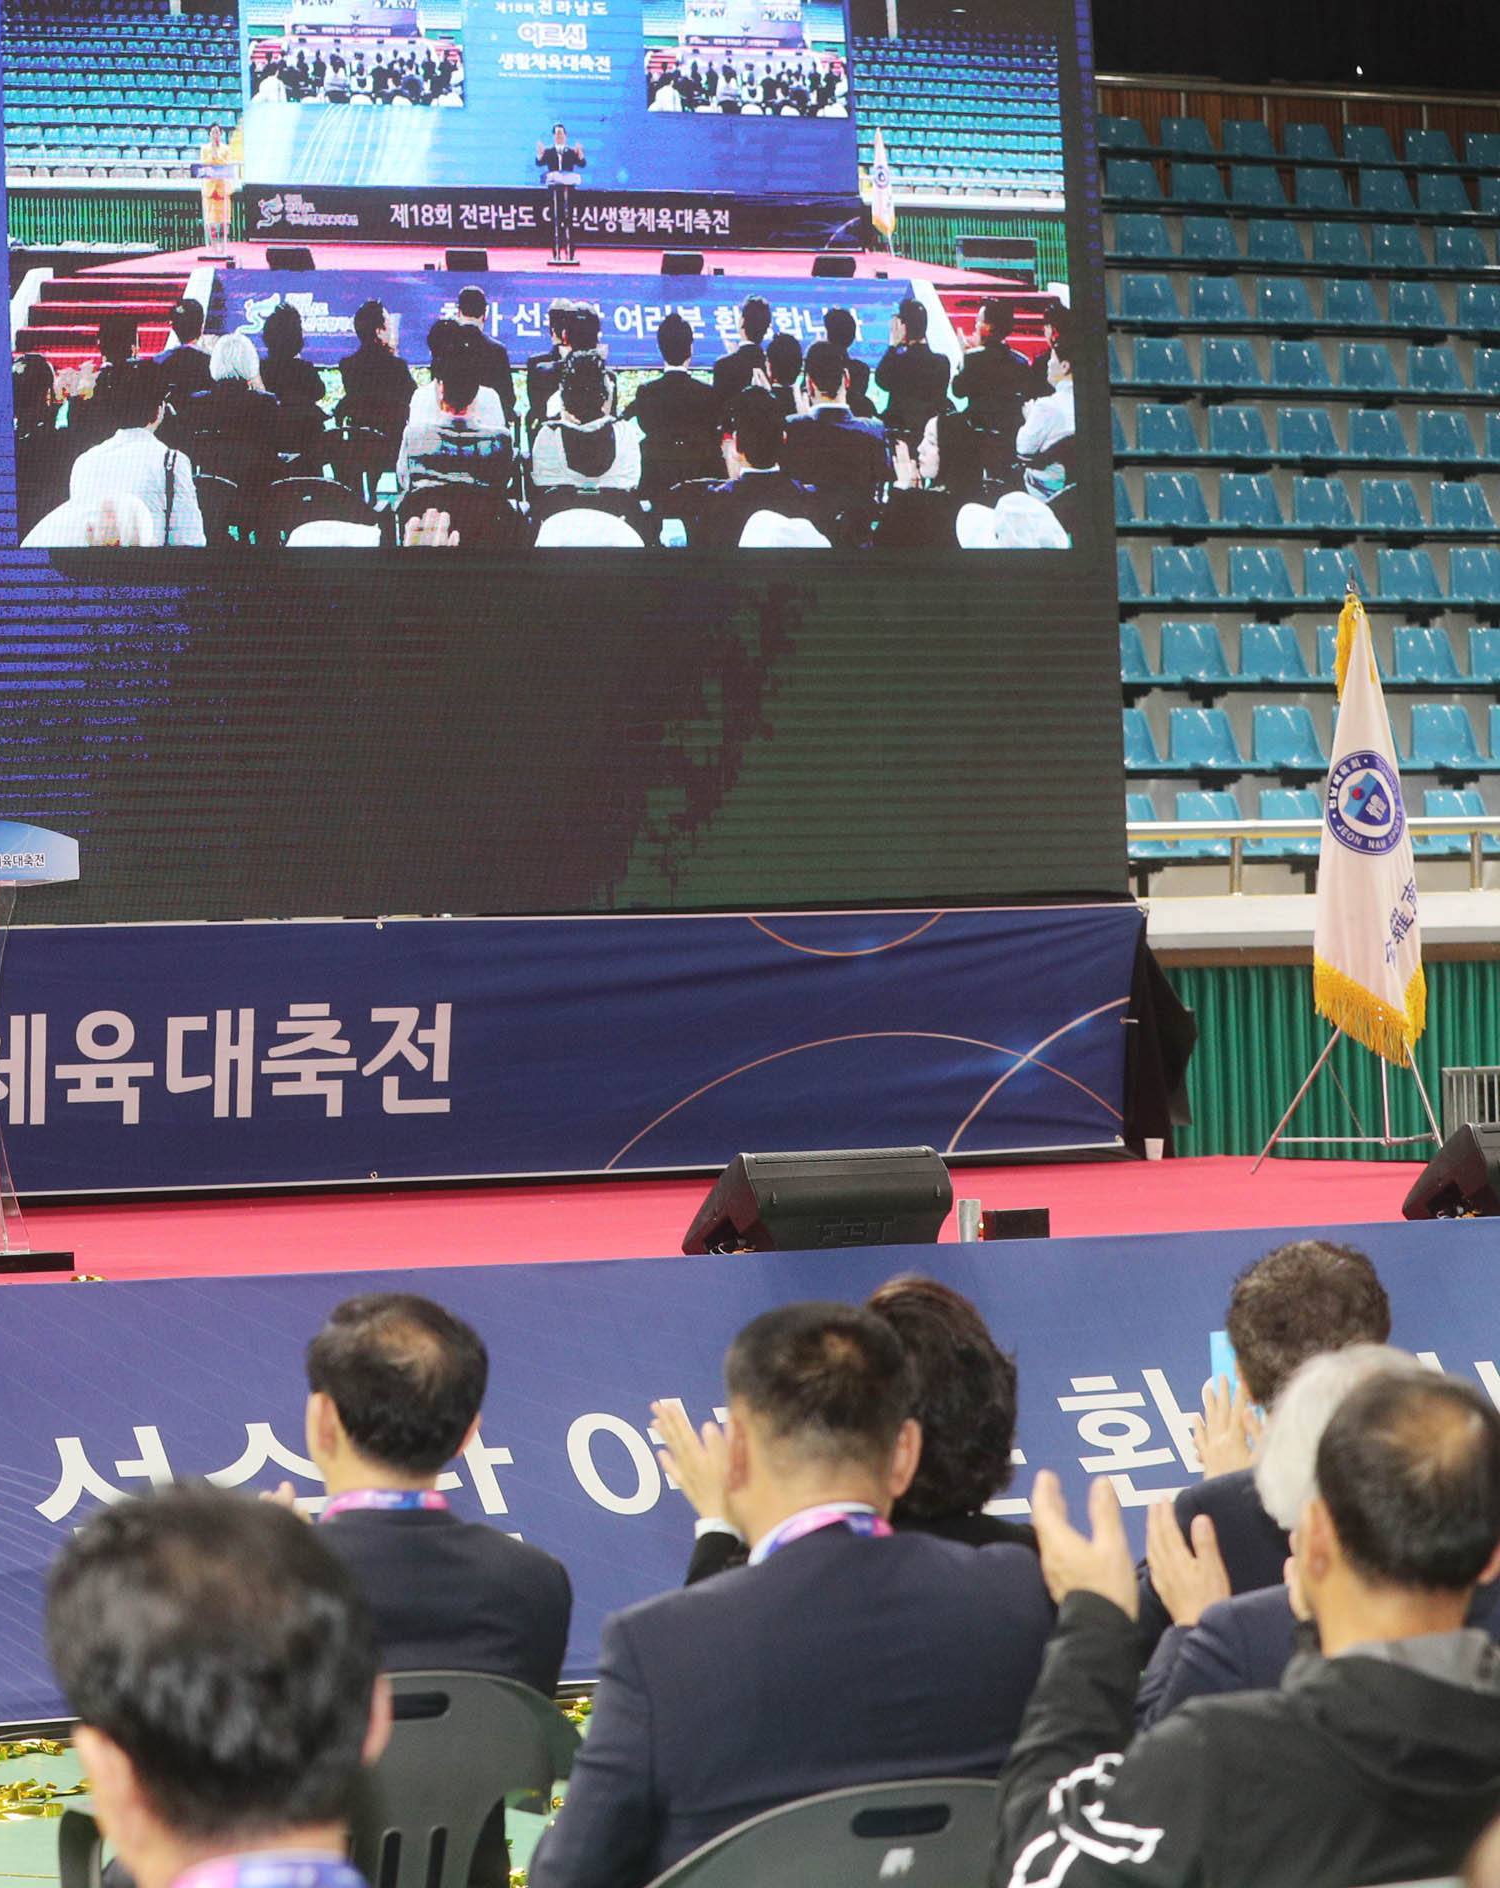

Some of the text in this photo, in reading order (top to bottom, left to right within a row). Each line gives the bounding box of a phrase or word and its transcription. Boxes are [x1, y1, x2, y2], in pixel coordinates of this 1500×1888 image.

[517, 22, 588, 50] 어르신
[389, 203, 453, 228] 제18회
[459, 203, 537, 230] 전라남도
[1336, 824, 1363, 846] JEON
